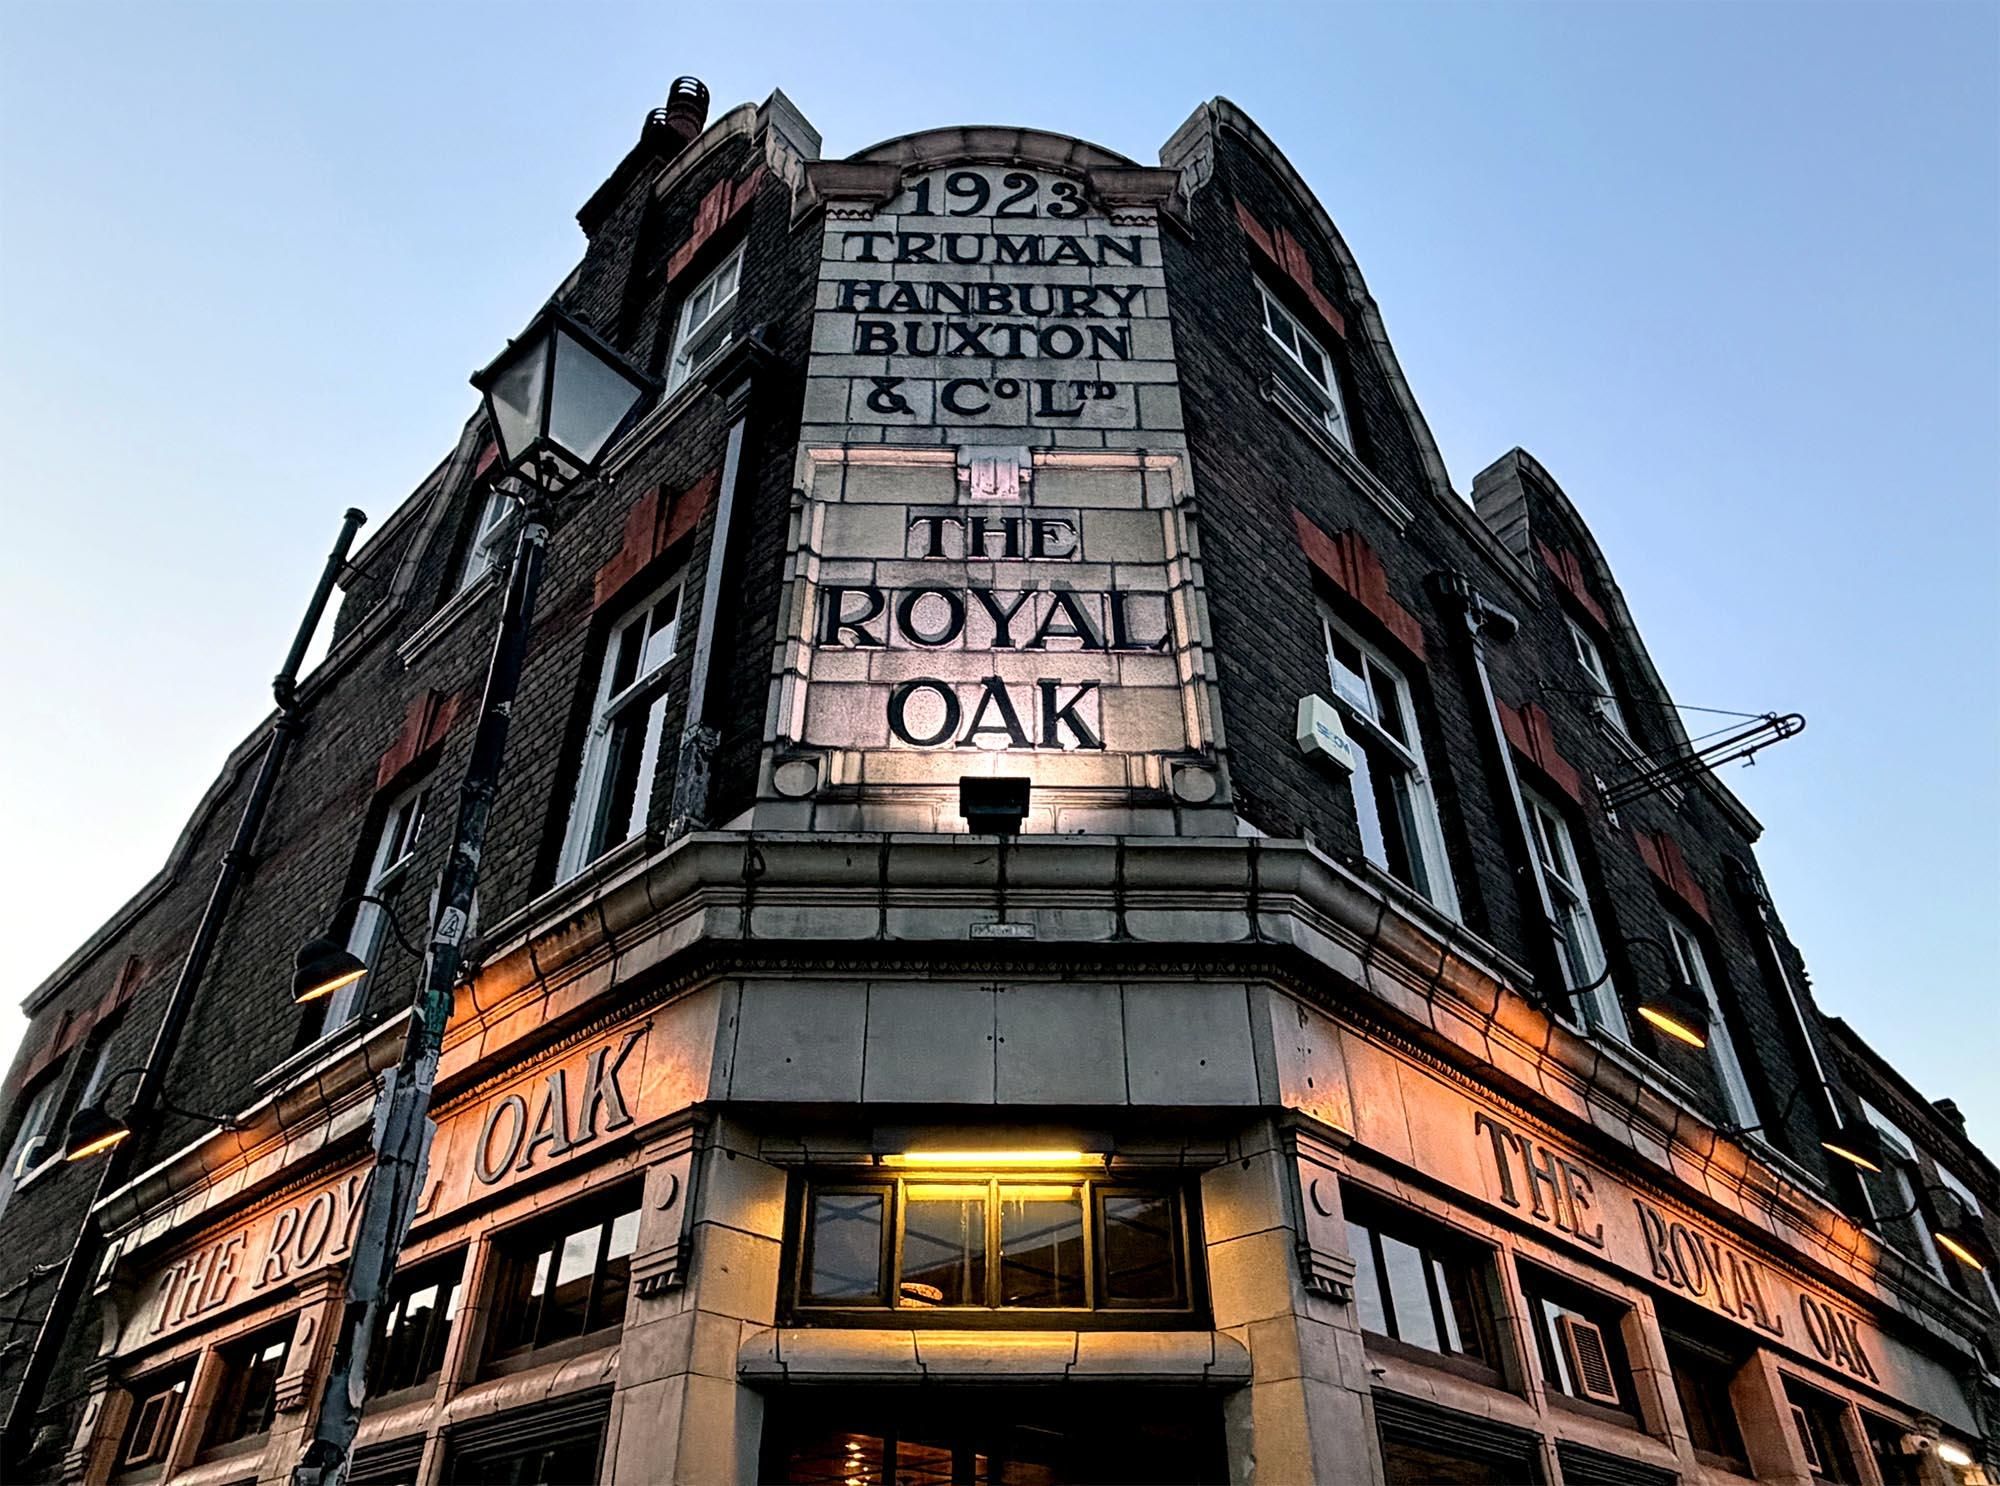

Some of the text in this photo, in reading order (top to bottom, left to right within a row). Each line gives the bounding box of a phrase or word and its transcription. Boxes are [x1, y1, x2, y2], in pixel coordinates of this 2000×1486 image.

[906, 171, 1088, 218] 1923
[844, 231, 1142, 266] TRUMAN
[838, 279, 1144, 318] HANBURY
[855, 321, 1130, 360] BUXTON
[866, 376, 914, 415] &
[910, 515, 1077, 560] THE
[817, 585, 1170, 652] ROYAL
[887, 677, 1106, 750] OAK
[150, 1230, 248, 1335] THE
[474, 1025, 653, 1185] OAK
[1475, 1111, 1880, 1386] THE ROYAL OAK
